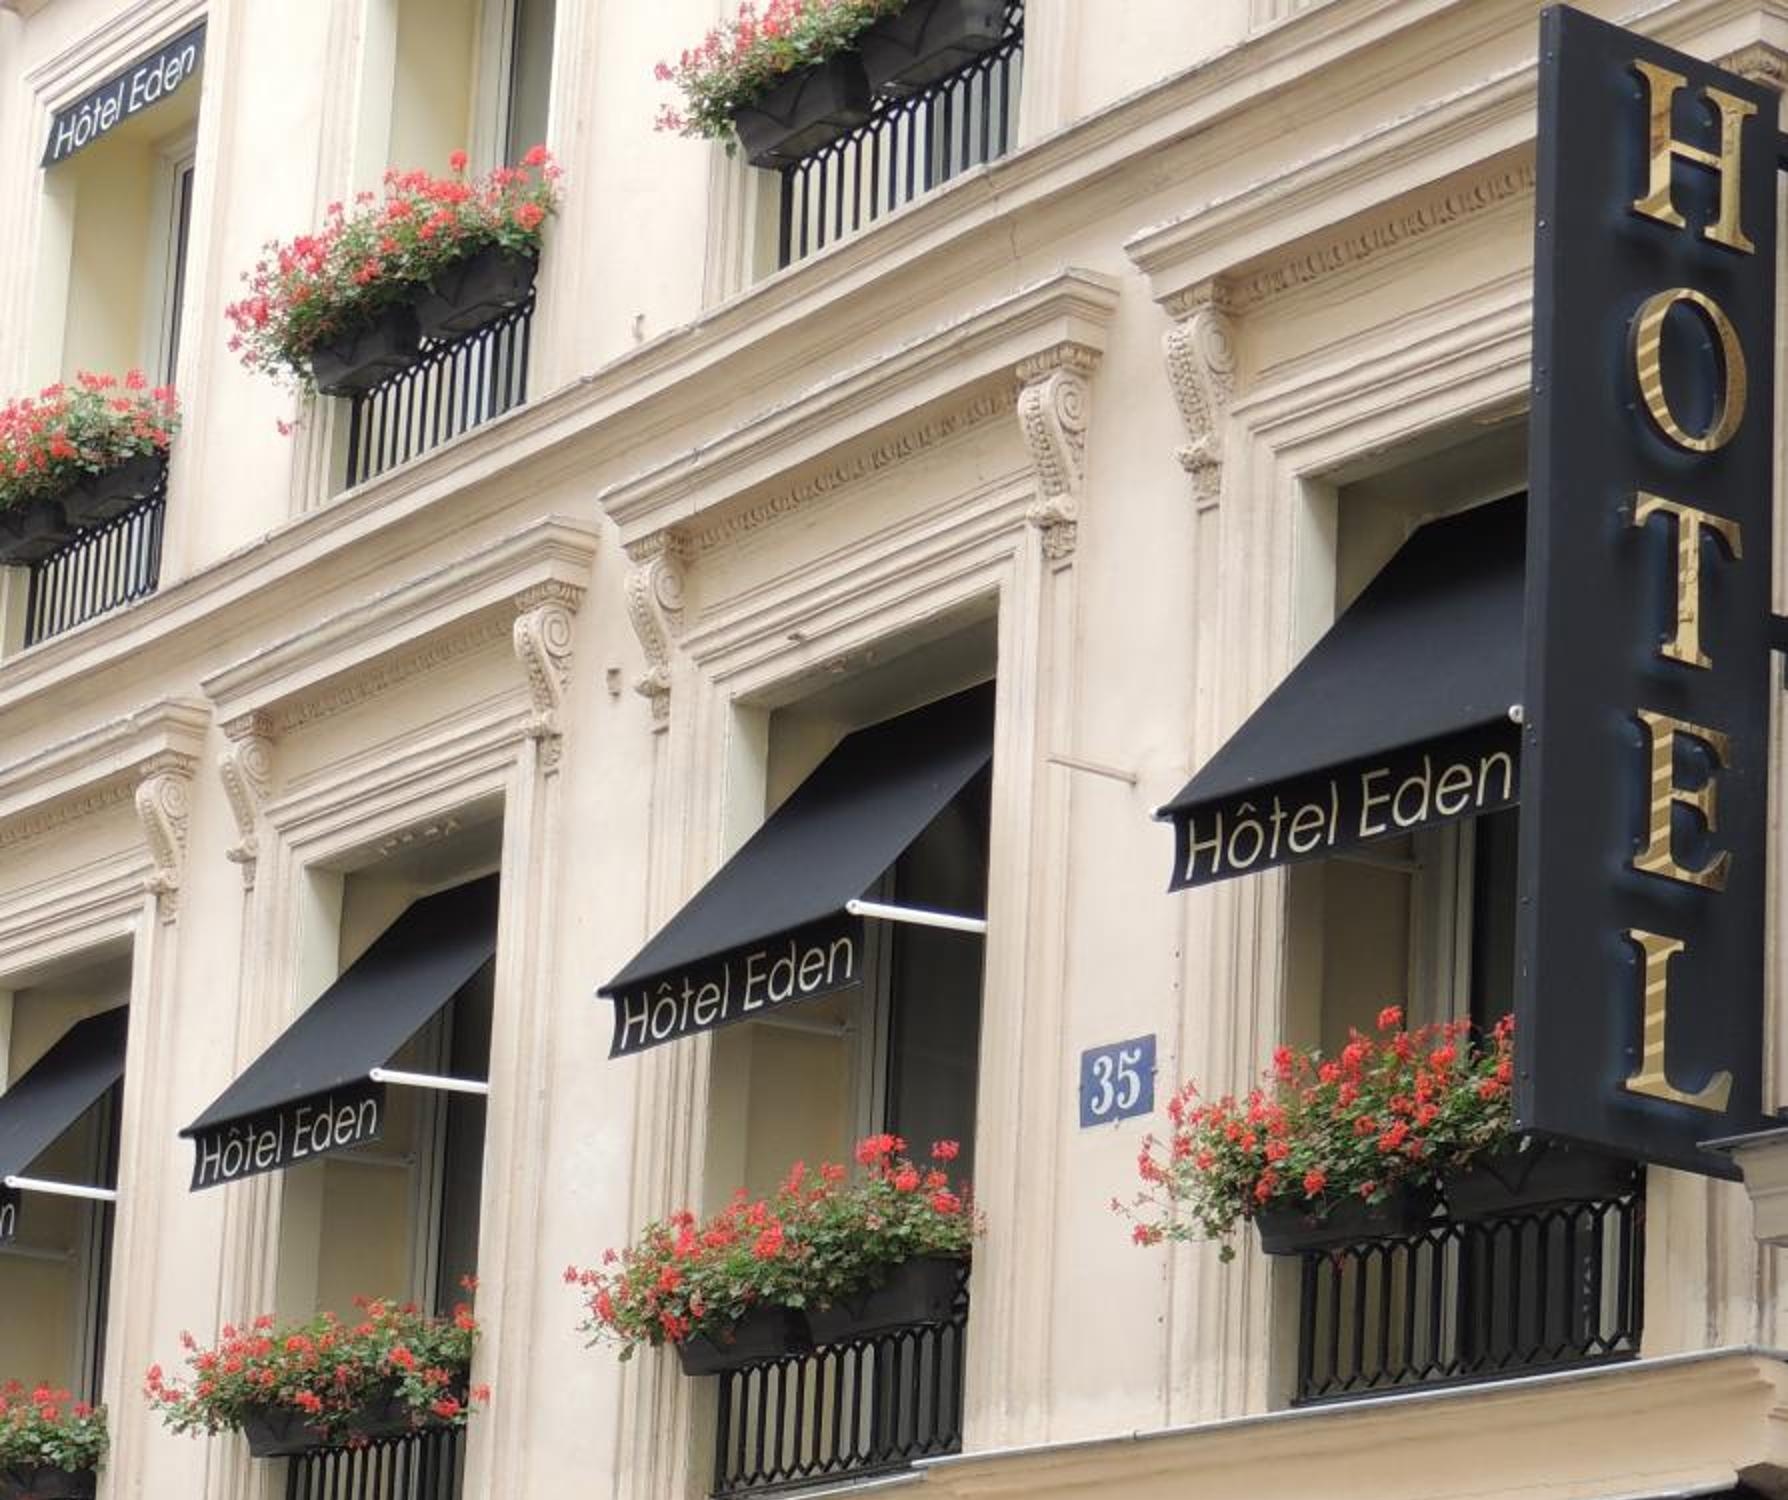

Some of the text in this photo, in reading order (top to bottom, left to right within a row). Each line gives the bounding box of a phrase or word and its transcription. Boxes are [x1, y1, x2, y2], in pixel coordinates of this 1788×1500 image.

[53, 43, 195, 158] Hôtel Eden
[1624, 58, 1758, 1113] HOTEL
[1185, 750, 1513, 881] Hôtel Eden
[620, 935, 854, 1049] Hôtel Eden
[1091, 1048, 1142, 1115] 35
[200, 1095, 378, 1184] Hôtel Eden
